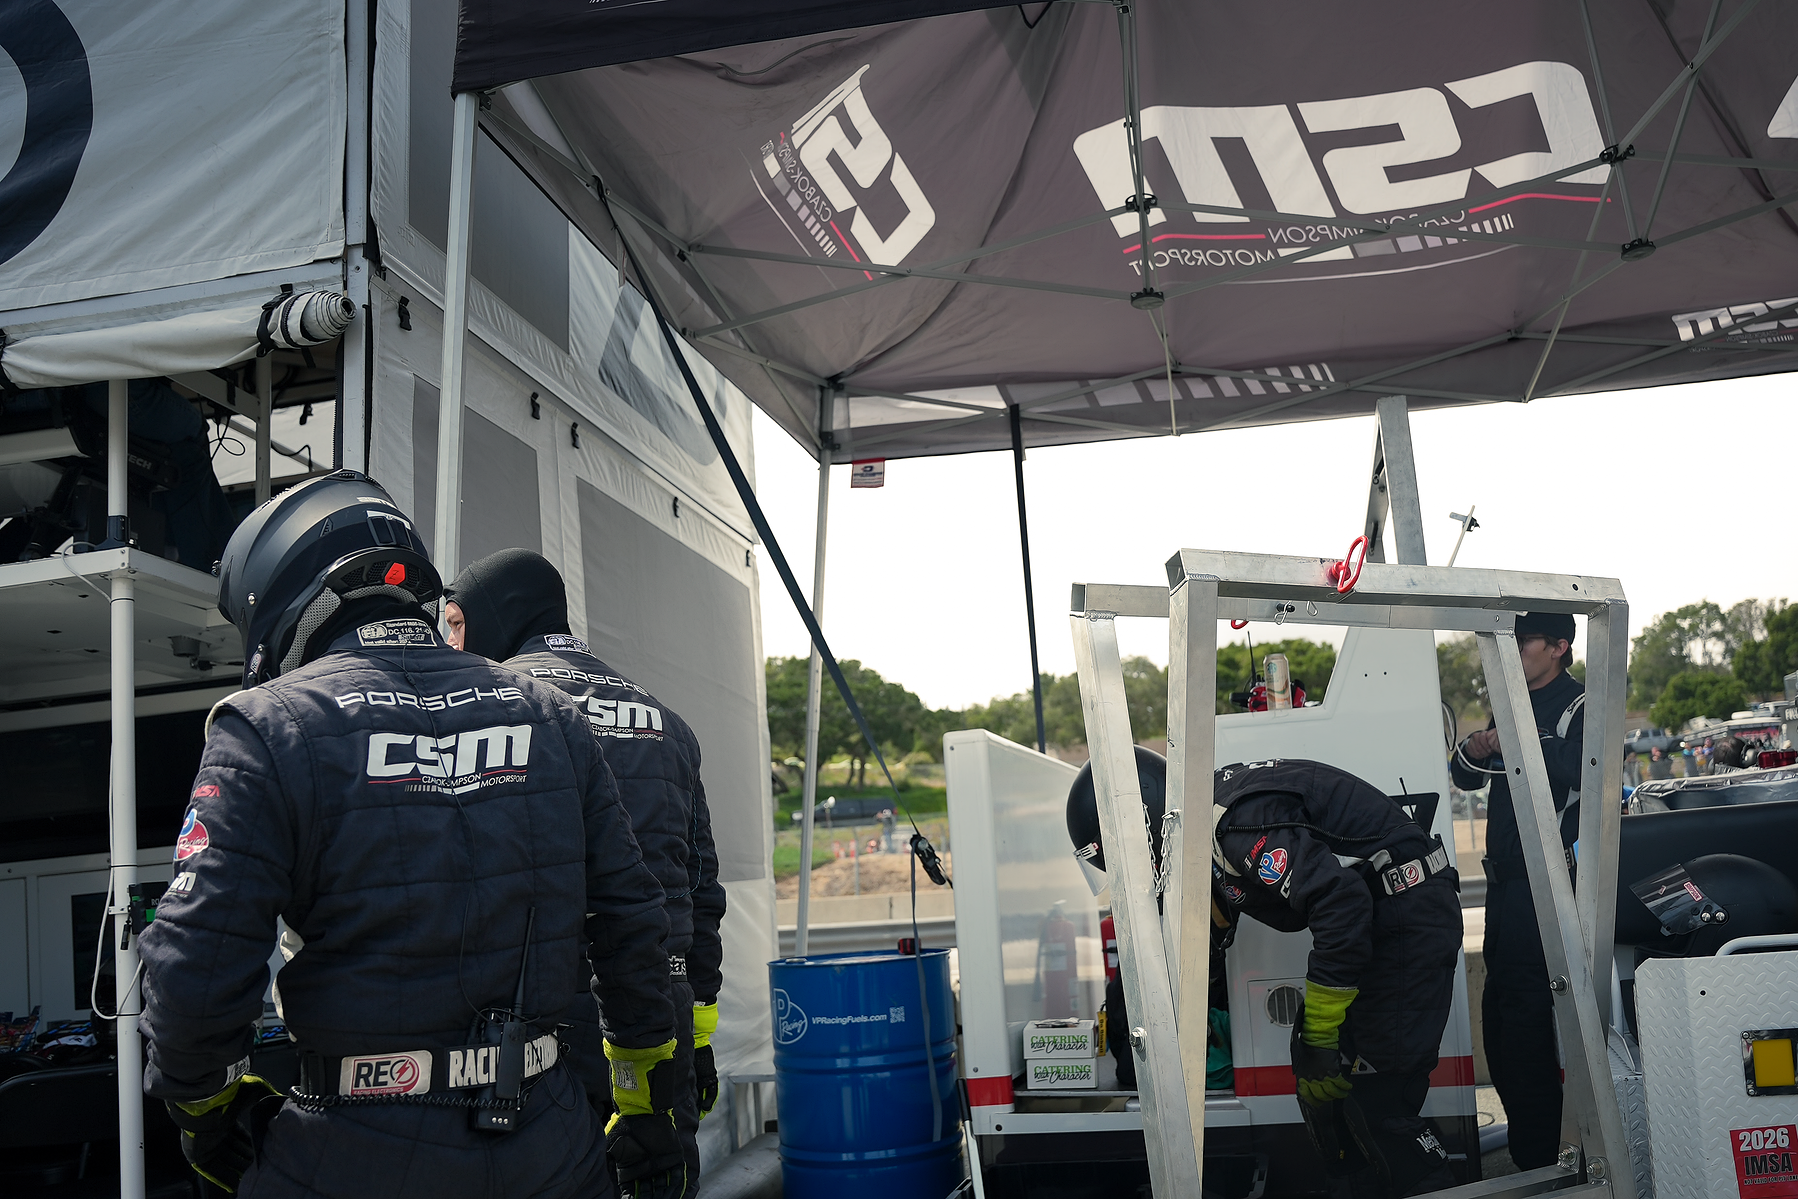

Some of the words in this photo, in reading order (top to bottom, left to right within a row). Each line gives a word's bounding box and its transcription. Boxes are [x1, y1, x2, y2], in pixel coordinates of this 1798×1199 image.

[529, 668, 649, 697] PORSCHE
[334, 687, 526, 712] PORSCHE
[480, 774, 527, 788] MOTORSPORT
[811, 1014, 887, 1025] VPRacingFuels.com
[1030, 1035, 1088, 1043] CATERING
[449, 1046, 500, 1088] RACI
[1034, 1065, 1092, 1074] CATERING
[1739, 1128, 1790, 1151] 2026
[1744, 1153, 1793, 1176] IMSA
